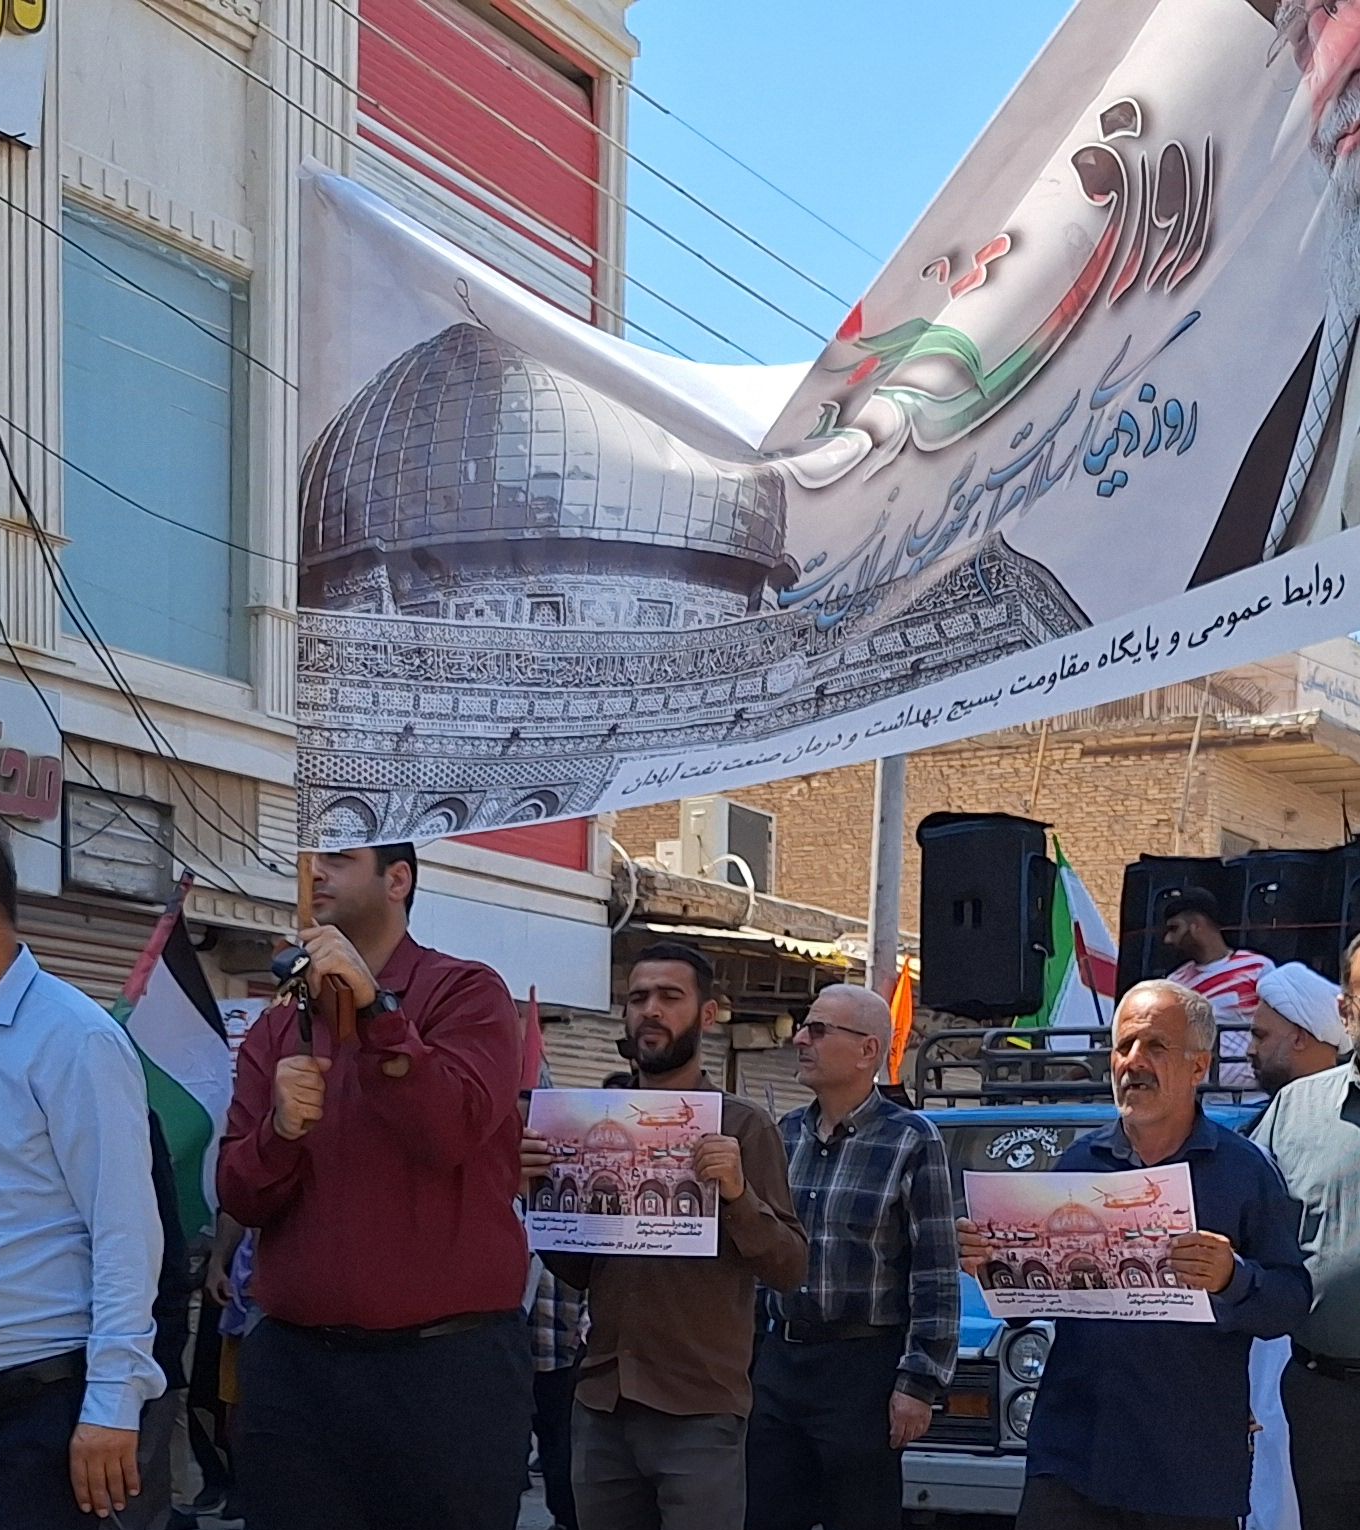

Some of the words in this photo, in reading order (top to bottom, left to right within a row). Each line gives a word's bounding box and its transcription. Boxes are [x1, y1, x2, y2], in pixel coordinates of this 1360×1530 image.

[1143, 384, 1198, 459] روز
[1281, 561, 1346, 608] روابط
[1187, 596, 1273, 649] عمومی
[1097, 625, 1161, 670] پایگاه
[1168, 632, 1181, 650] و
[1009, 654, 1091, 695] مقاومت
[864, 702, 943, 738] بهداشت
[946, 686, 1003, 722] بسیج
[782, 732, 843, 764] درمان
[844, 731, 858, 750] و
[680, 758, 722, 780] نفت
[721, 748, 782, 772] صنعت
[621, 762, 678, 796] آبادان
